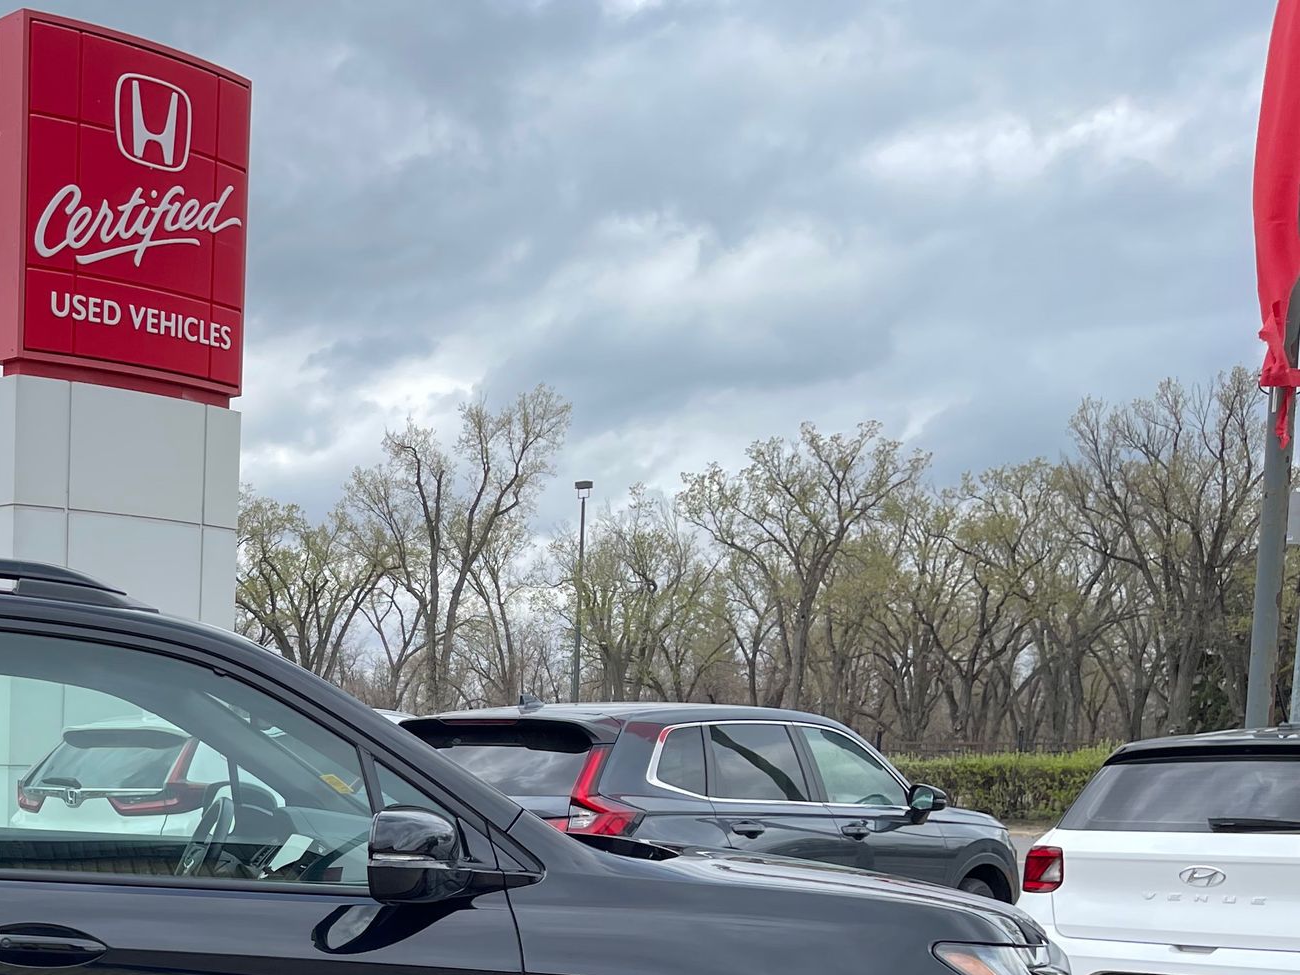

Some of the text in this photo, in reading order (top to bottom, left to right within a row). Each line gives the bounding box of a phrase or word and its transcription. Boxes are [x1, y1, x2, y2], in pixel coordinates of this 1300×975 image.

[34, 184, 242, 267] Certified
[51, 291, 231, 350] USED VEHICLES
